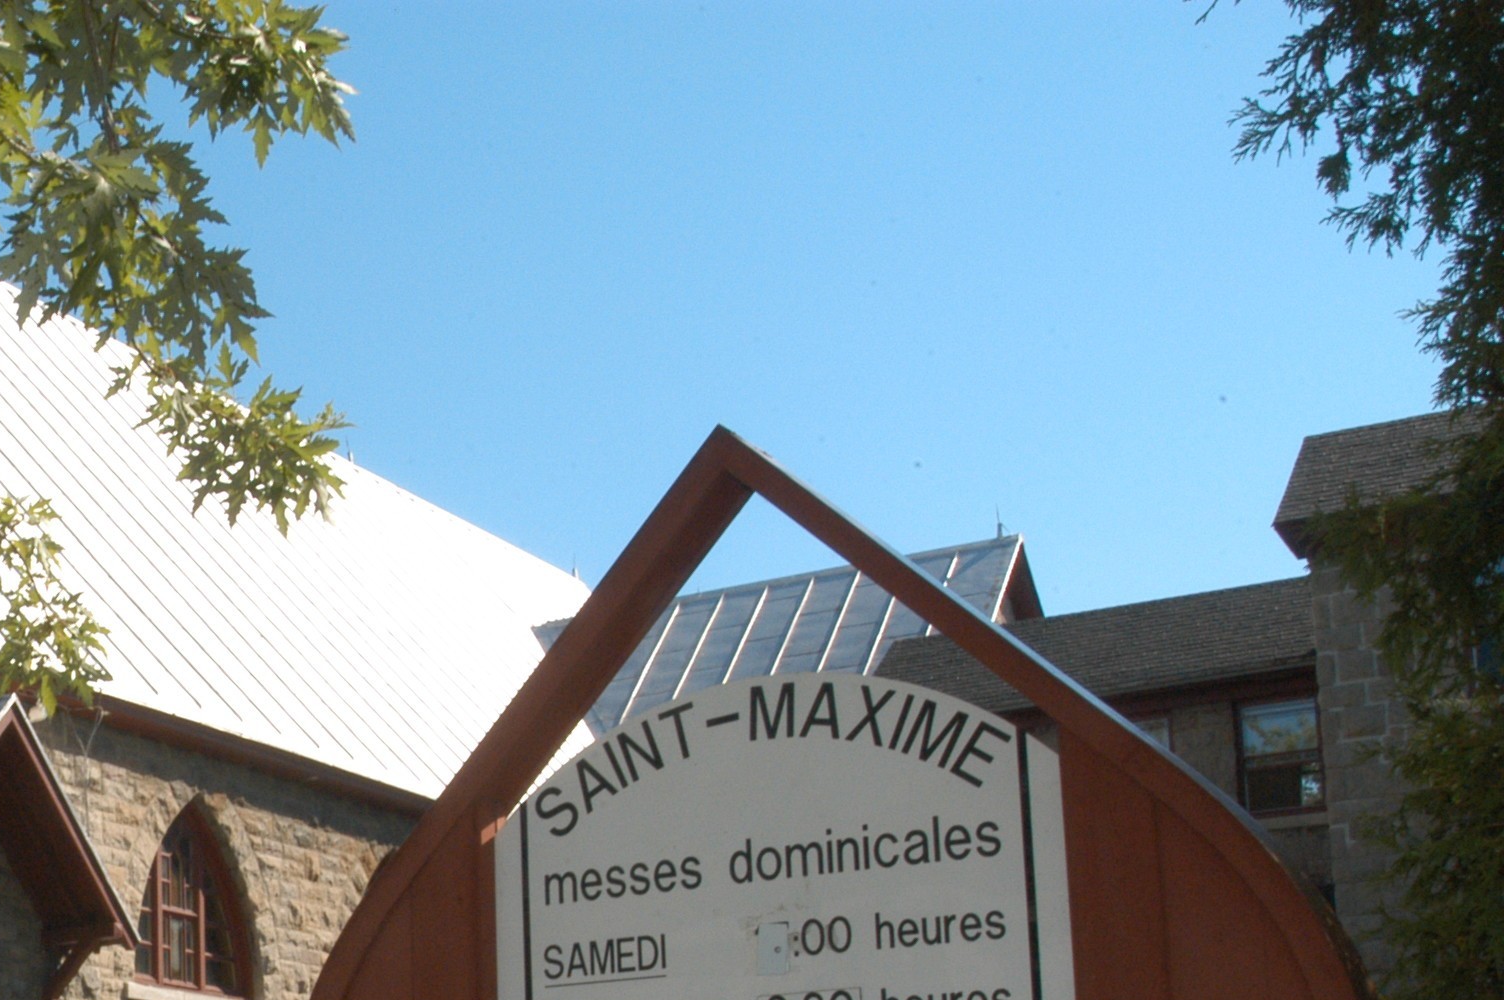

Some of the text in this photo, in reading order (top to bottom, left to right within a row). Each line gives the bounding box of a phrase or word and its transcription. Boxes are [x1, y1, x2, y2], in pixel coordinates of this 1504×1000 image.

[543, 816, 1002, 905] messes dominicales
[543, 934, 667, 980] SAMEDI
[874, 910, 1007, 951] heures
